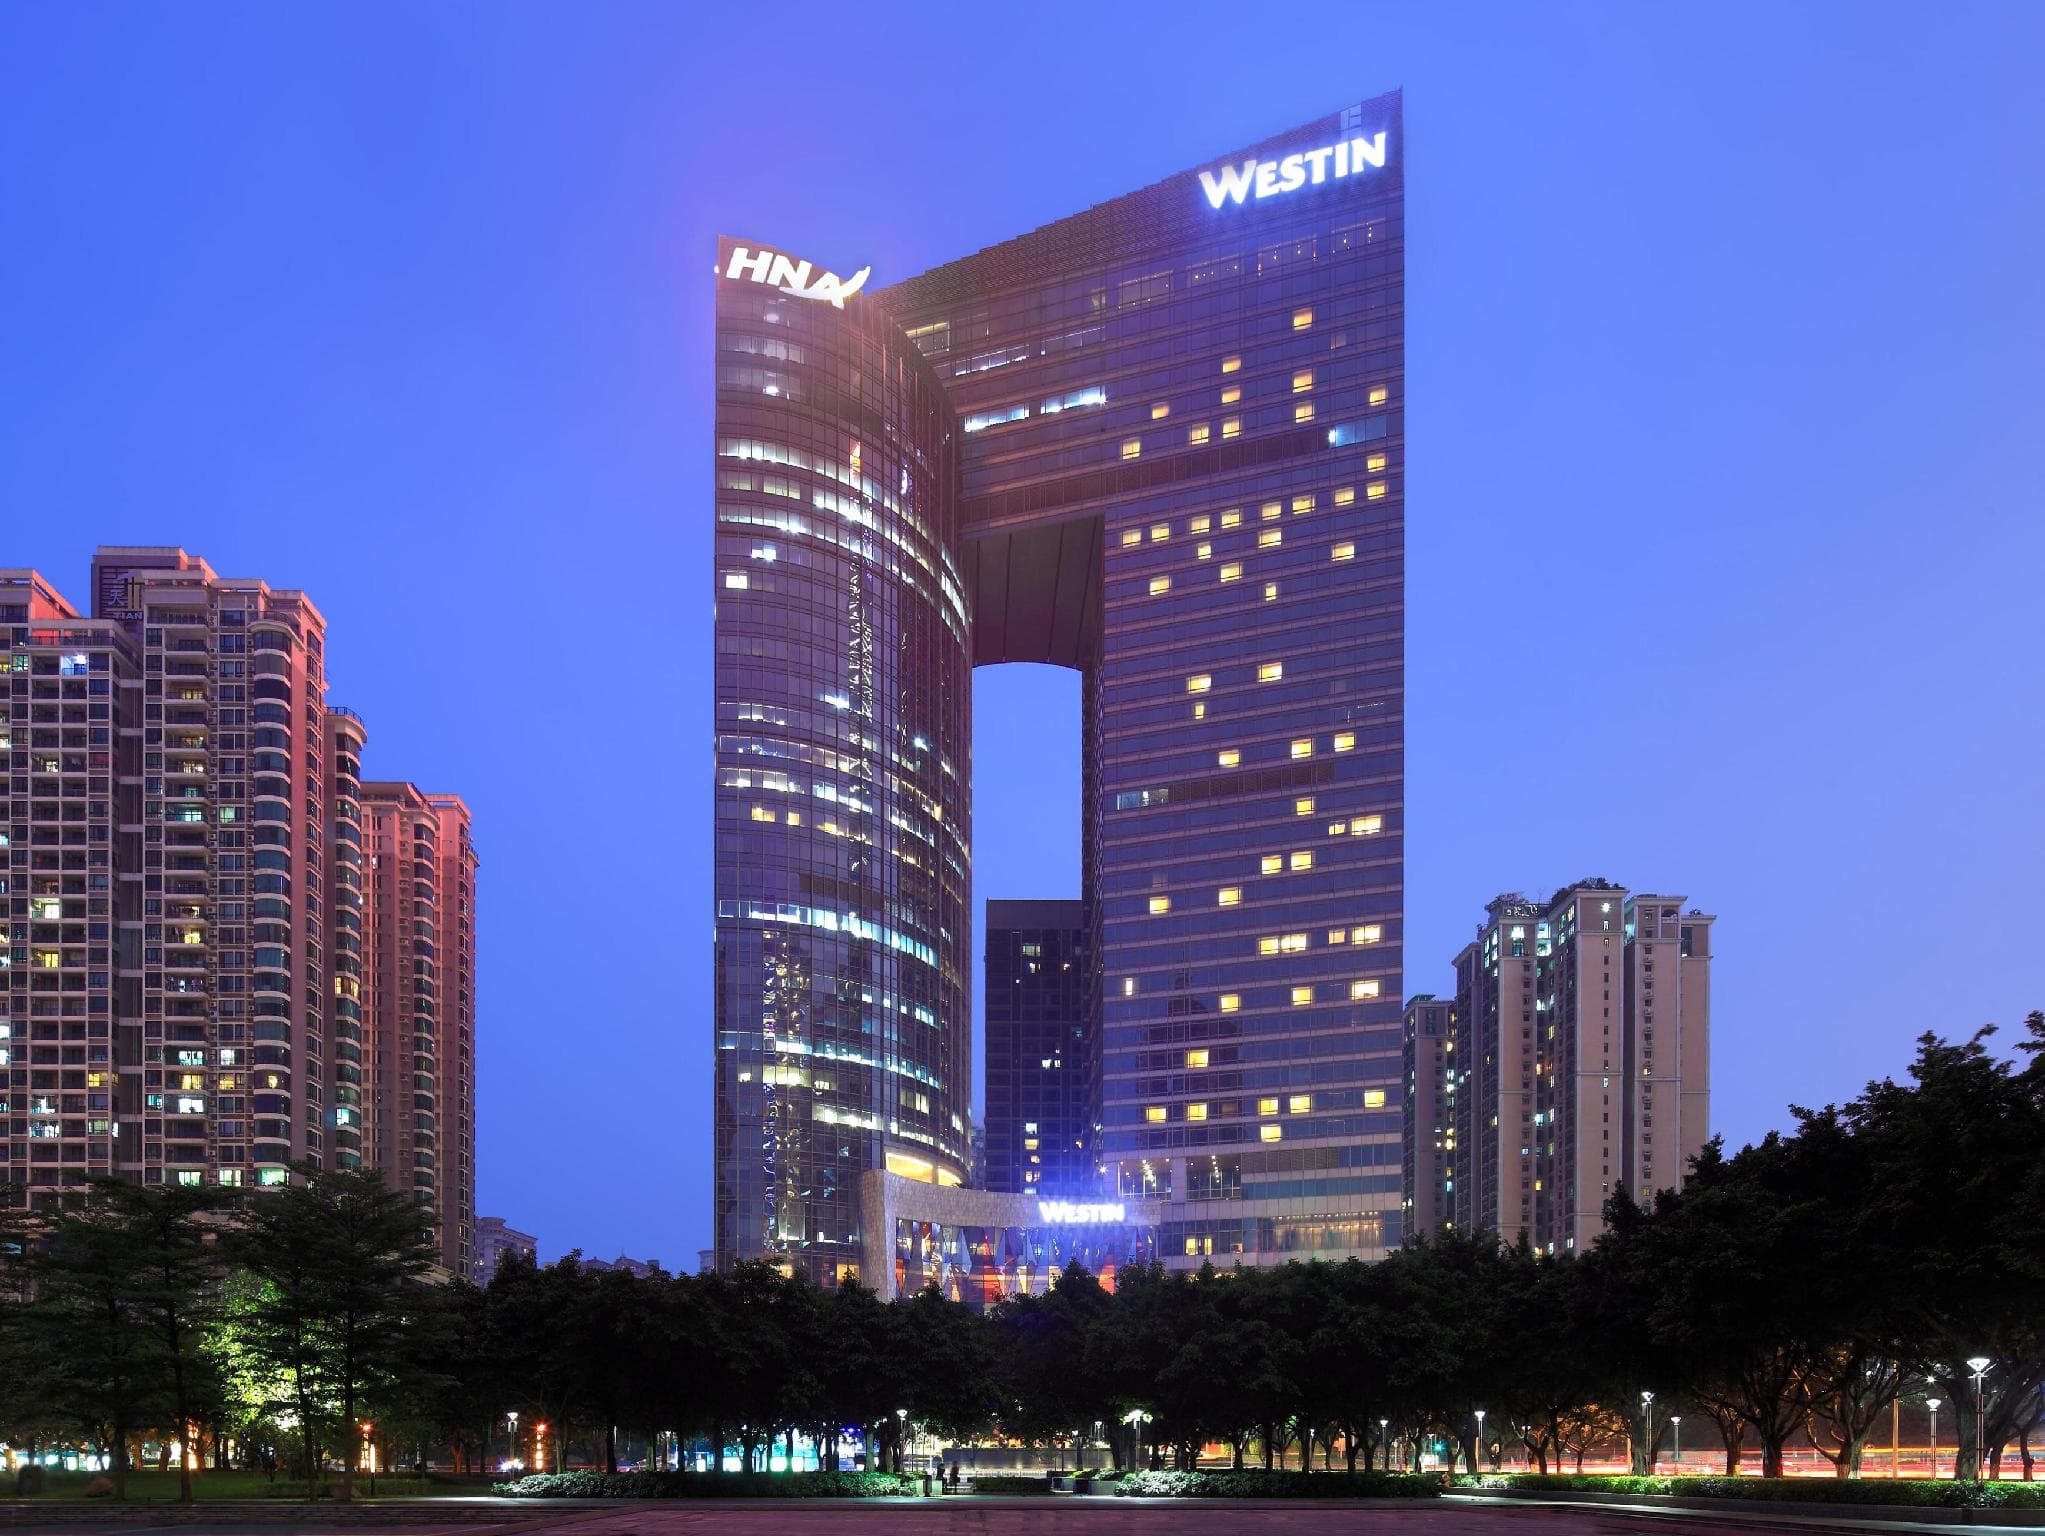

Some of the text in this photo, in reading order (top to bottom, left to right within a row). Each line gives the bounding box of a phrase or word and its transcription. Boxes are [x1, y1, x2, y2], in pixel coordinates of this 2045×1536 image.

[1199, 131, 1387, 209] WESTIN
[726, 247, 870, 310] HNA
[1038, 1200, 1125, 1223] WESTIN
